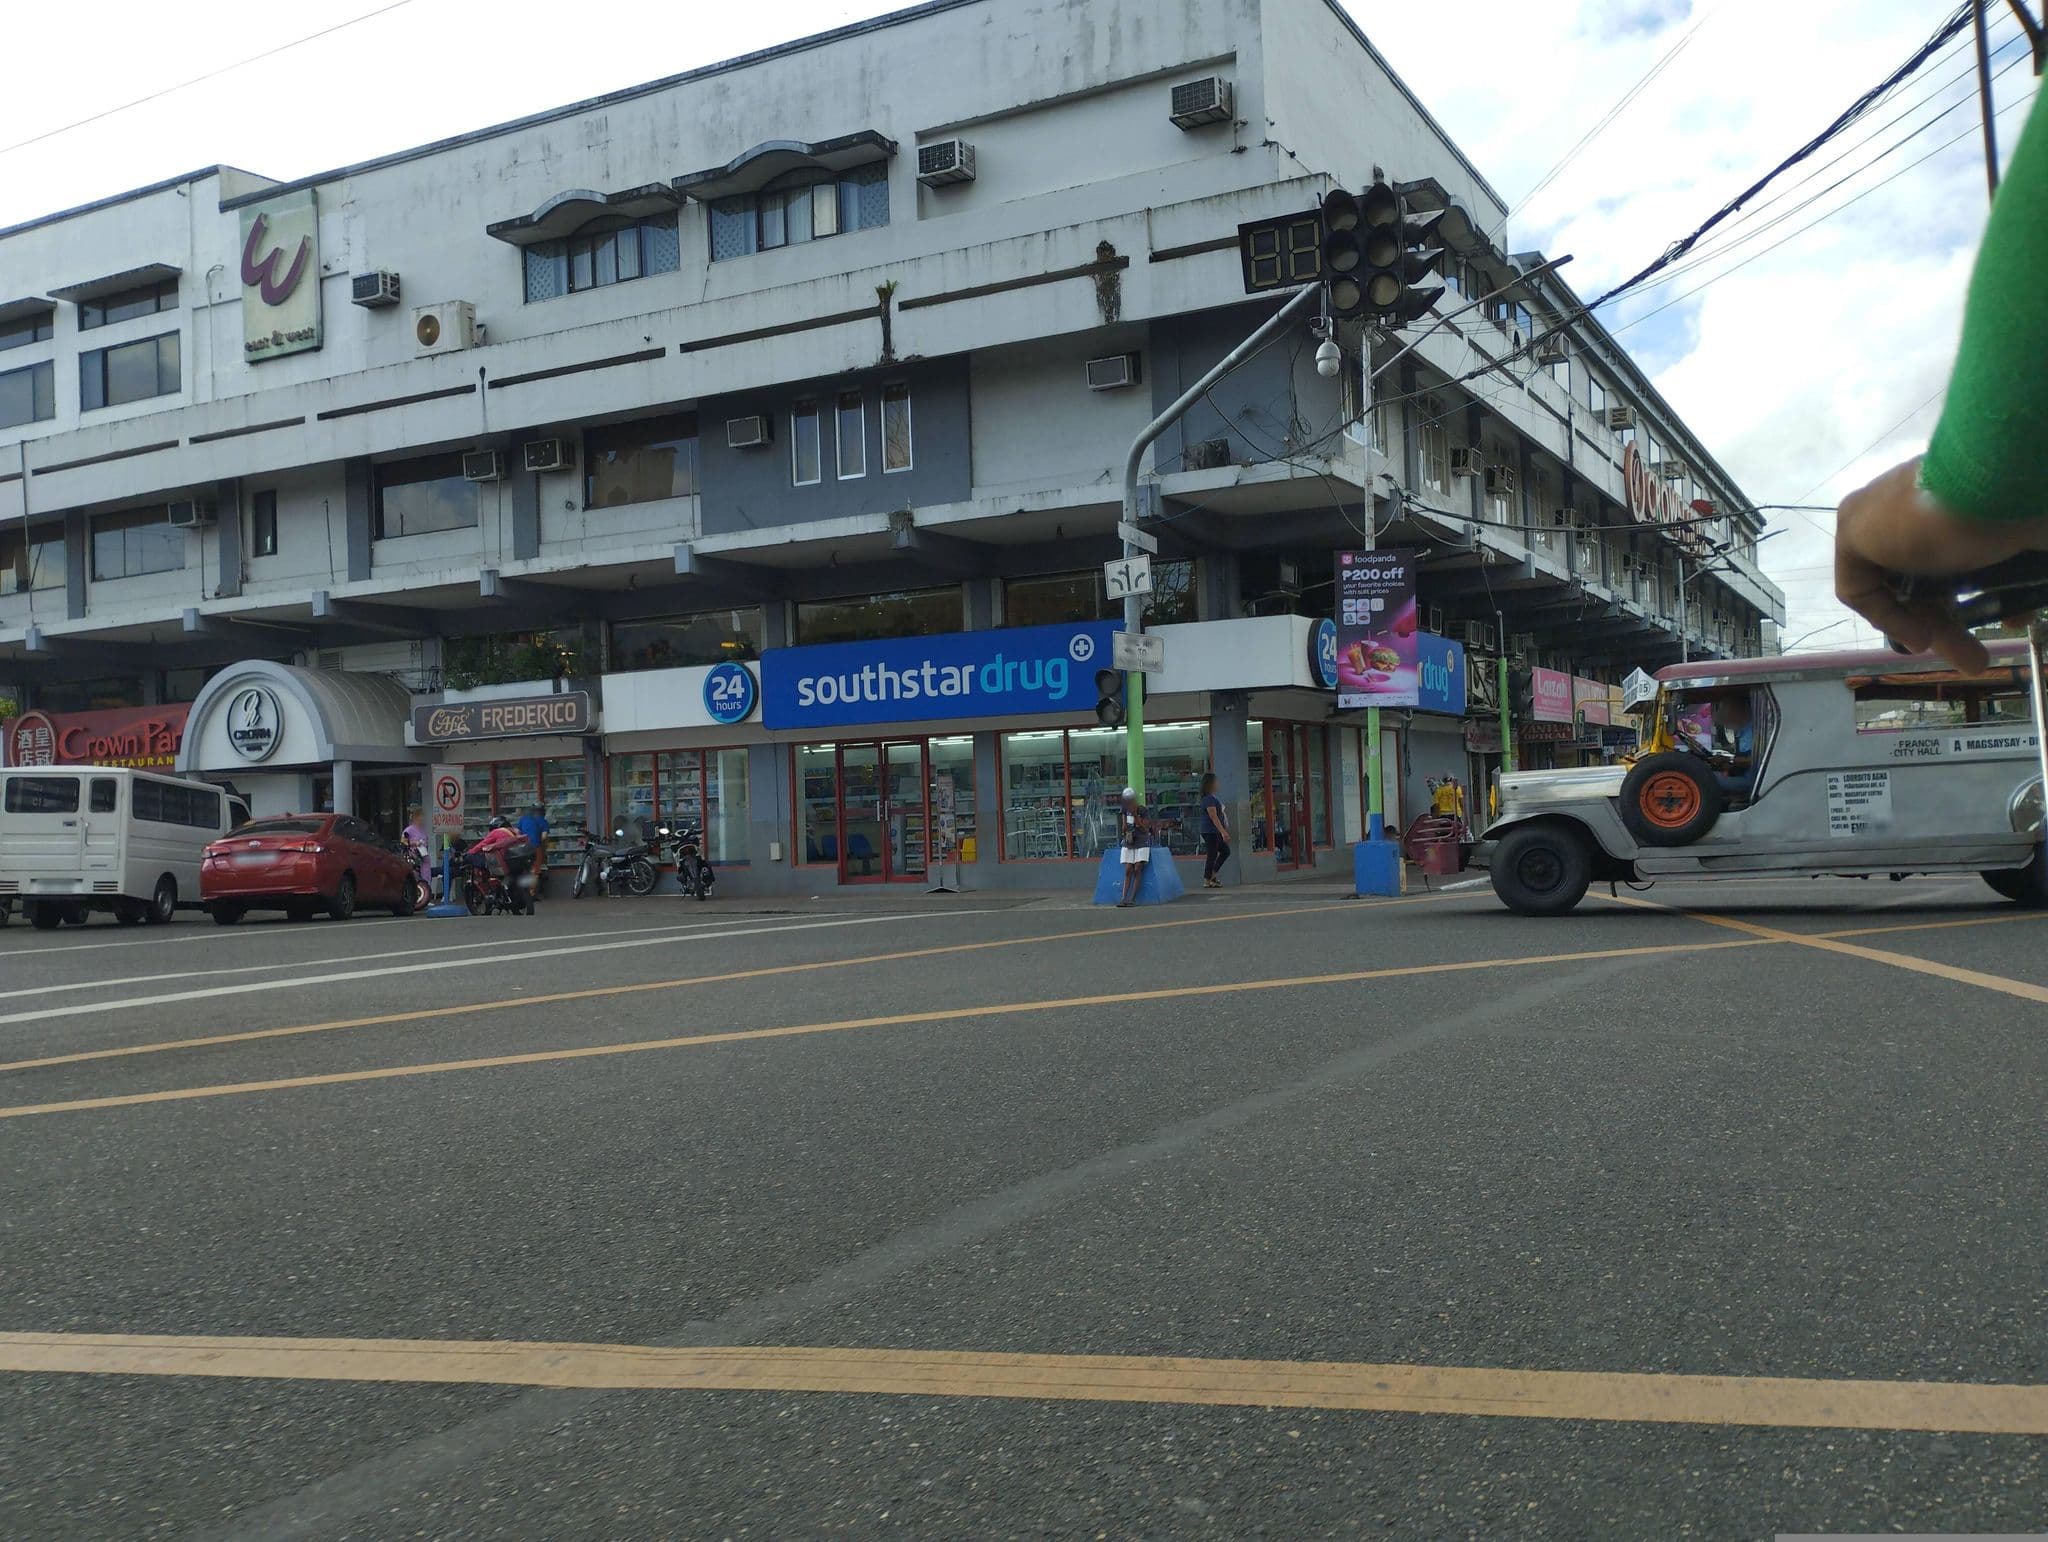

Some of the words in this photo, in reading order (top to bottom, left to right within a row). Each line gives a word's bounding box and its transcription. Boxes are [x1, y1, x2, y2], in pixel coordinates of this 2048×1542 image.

[1355, 554, 1396, 564] foodpanda
[1382, 567, 1404, 579] off
[798, 660, 975, 707] southstar
[980, 653, 1068, 700] drug
[1424, 656, 1448, 702] drug
[712, 674, 744, 700] 24
[716, 701, 742, 711] hours
[481, 702, 576, 731] FREDERICO
[59, 726, 137, 760] Crown
[1954, 740, 1962, 752] A
[1966, 738, 2020, 750] MAGSAYSAY
[1894, 748, 1914, 757] CITY
[1917, 748, 1941, 756] HALL
[94, 755, 175, 767] RESTAURAN
